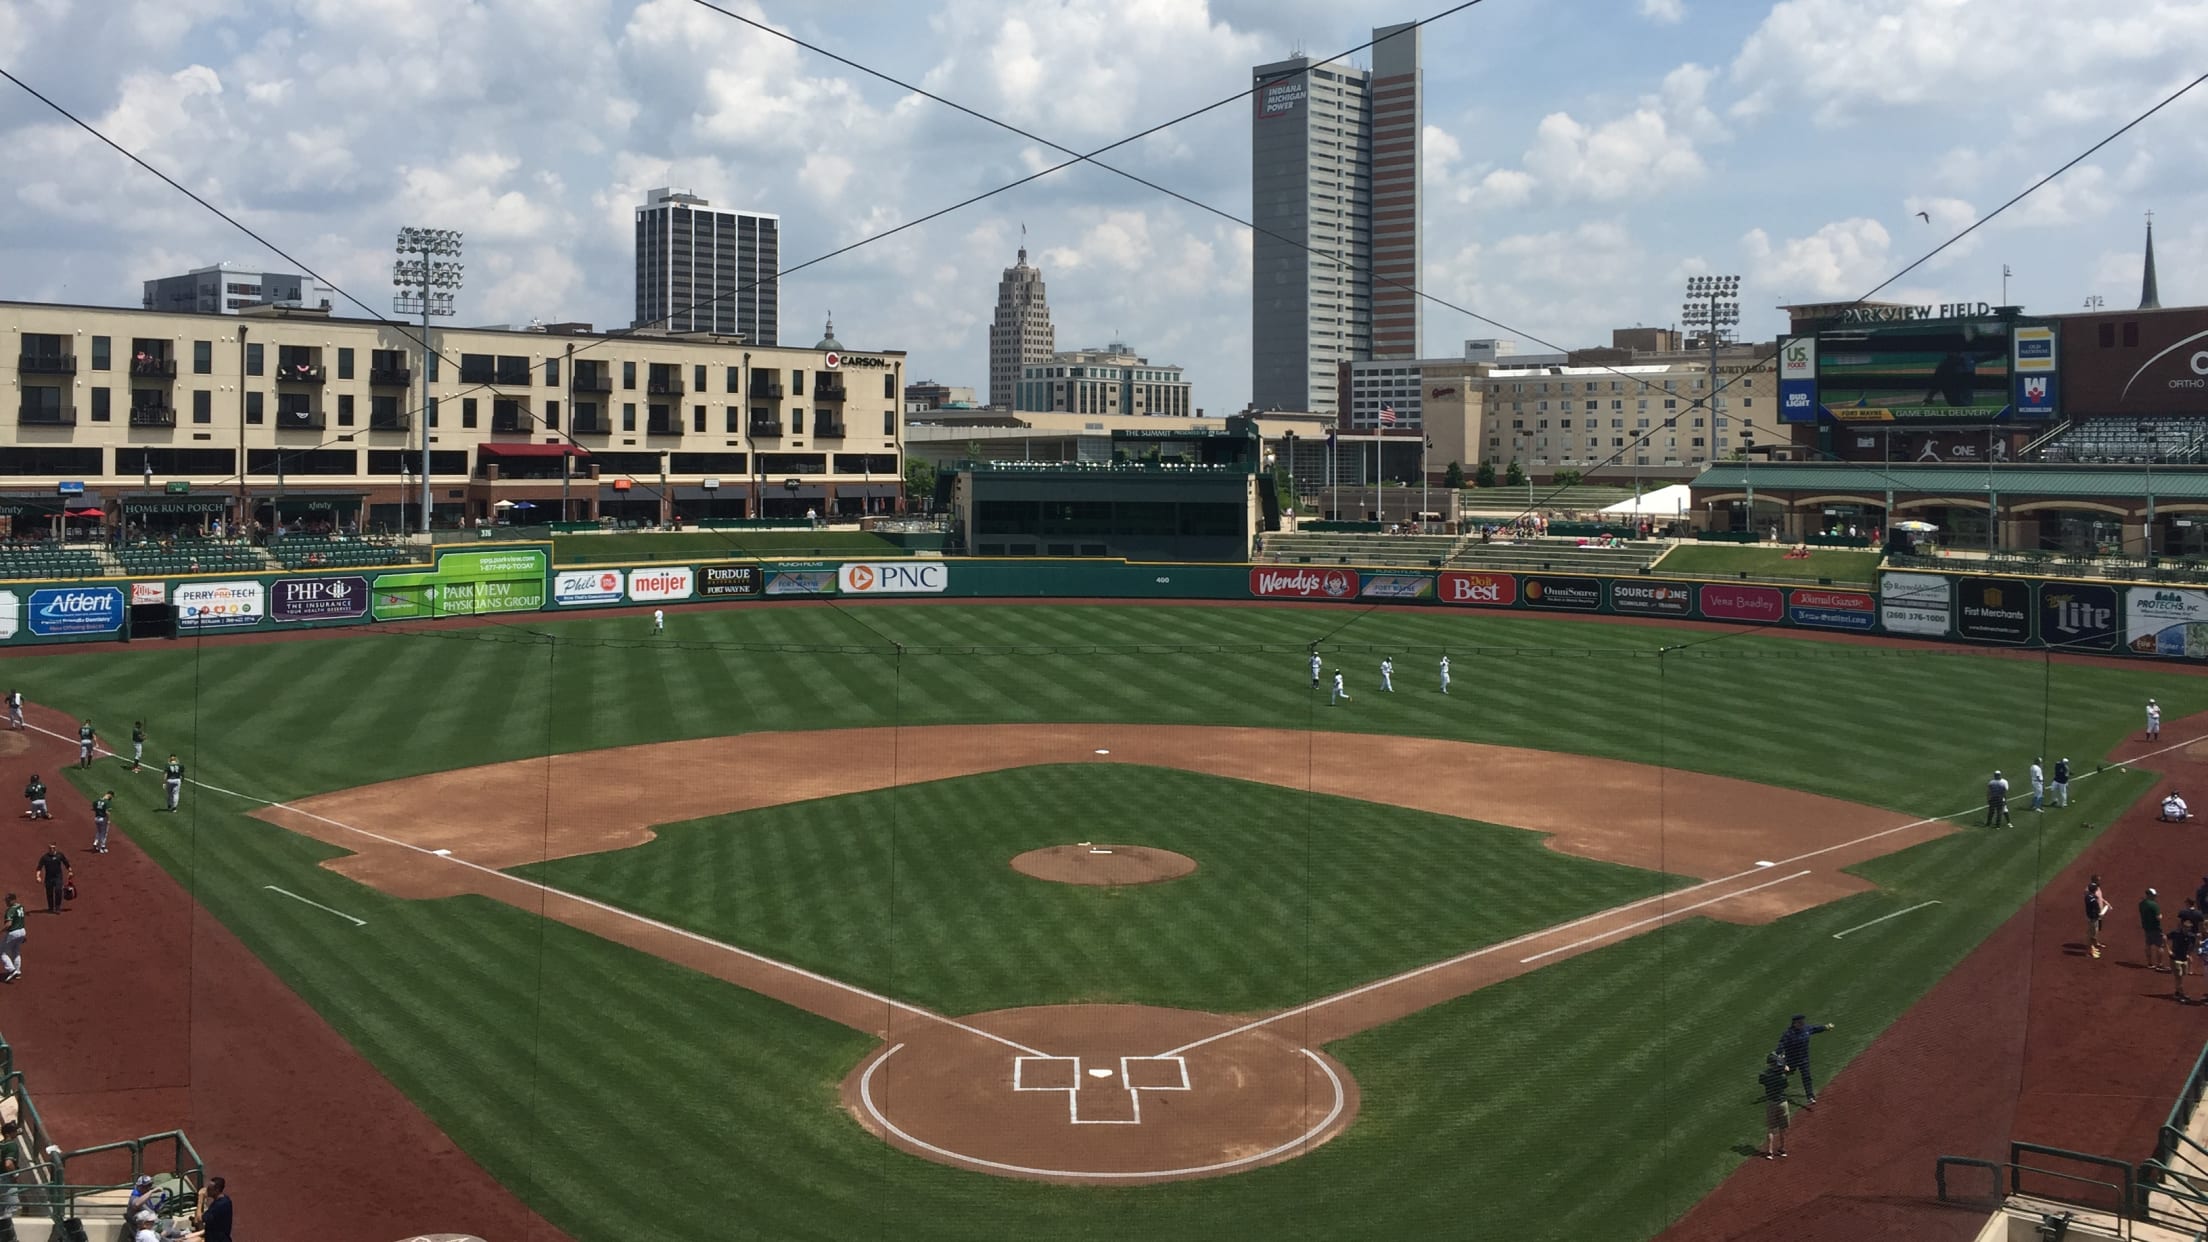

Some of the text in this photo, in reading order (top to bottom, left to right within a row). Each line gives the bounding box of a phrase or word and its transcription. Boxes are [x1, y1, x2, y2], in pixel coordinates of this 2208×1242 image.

[1269, 84, 1302, 97] INDIANA
[1268, 91, 1306, 104] MICHIGAN
[1266, 102, 1294, 113] POWER
[1842, 302, 1990, 324] PARKVIEW FIELD
[840, 356, 885, 366] CARSON
[2168, 379, 2205, 389] ORTHO
[1789, 393, 1808, 401] BUD
[1895, 408, 1993, 418] GAME BALL DELIVERY
[1952, 445, 1976, 457] ONE
[125, 503, 223, 514] HOME RUN PORCH
[308, 501, 332, 511] xfinity
[708, 568, 751, 580] PURDUE
[879, 566, 938, 588] PNC
[1156, 576, 1170, 584] 400
[1470, 576, 1485, 585] Do
[563, 575, 596, 593] Phil's
[636, 572, 686, 594] meijer
[1259, 569, 1320, 596] Wendy's
[1453, 578, 1500, 600] Best
[286, 582, 324, 601] PHP
[443, 583, 511, 600] PARKVIEW
[707, 585, 751, 594] FORT WAYNE
[1543, 586, 1599, 598] OmniSource
[1614, 586, 1688, 600] SOURCE ONE
[47, 592, 114, 612] Afdent
[305, 600, 352, 609] INSURANCE
[443, 595, 541, 611] PHYSICIANS GROUP
[1710, 594, 1774, 612] Vera Bradley
[1801, 594, 1864, 608] Journal Gazette
[1886, 611, 1946, 623] (260) 376-1000
[1964, 606, 2025, 620] First Merchants
[2056, 599, 2112, 634] Lite
